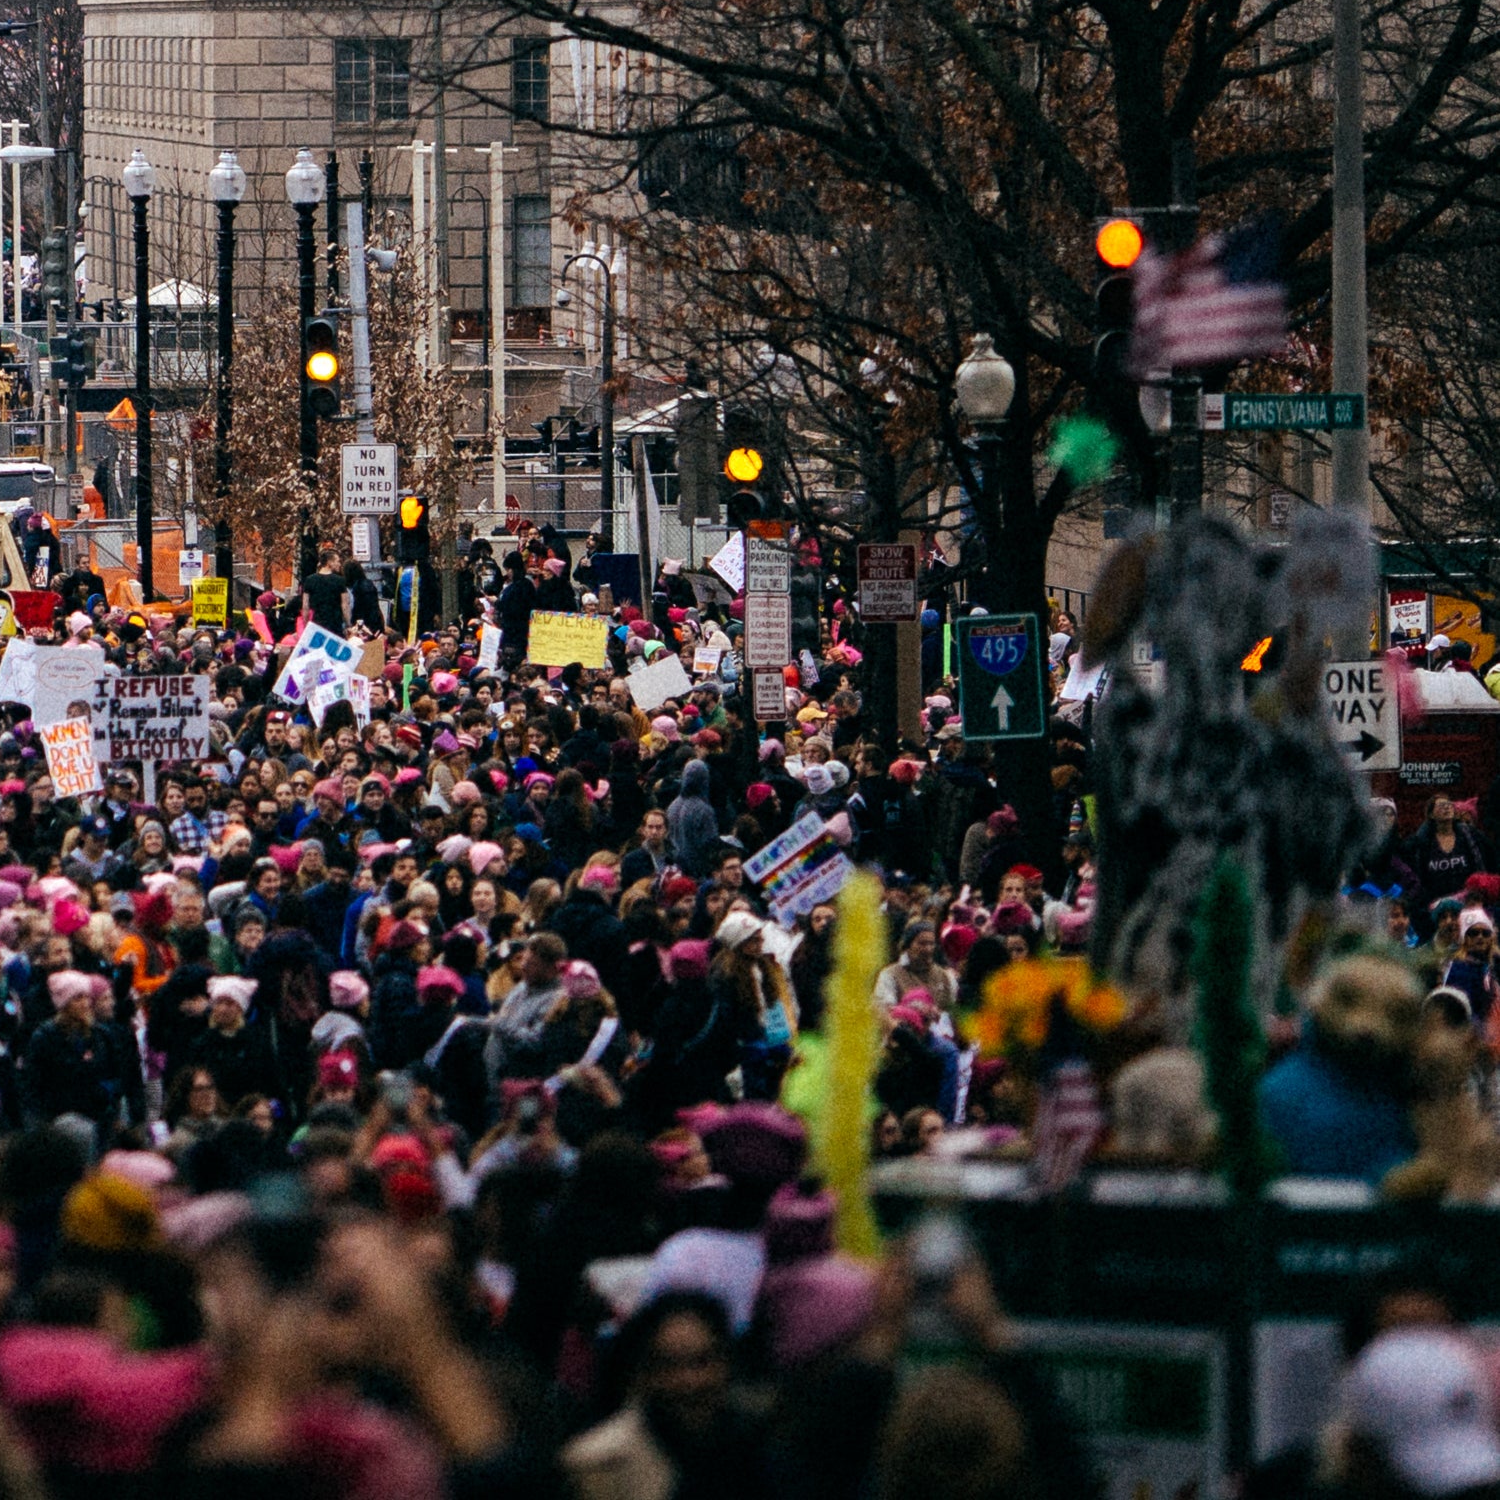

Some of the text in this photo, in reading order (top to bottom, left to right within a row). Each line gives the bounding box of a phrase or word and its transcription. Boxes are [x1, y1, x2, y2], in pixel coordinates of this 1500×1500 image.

[1231, 401, 1328, 424] PENNSYVANIA
[360, 449, 376, 460] NO
[354, 466, 385, 477] TURN
[347, 481, 391, 492] ON RED
[347, 497, 390, 508] 7AM-7PM
[750, 553, 786, 564] PARKING
[870, 547, 903, 557] SNOW
[868, 568, 905, 579] ROUTE
[863, 582, 912, 592] NO PARKING
[532, 613, 605, 630] NEW JERSEY
[750, 611, 786, 619] VEHICLES
[750, 621, 786, 629] LOADING
[981, 637, 1019, 663] 495
[94, 678, 109, 698] I
[114, 676, 194, 698] REFUSE
[1325, 668, 1385, 694] ONE
[110, 697, 203, 718] Remain Silent
[42, 722, 90, 744] WOMEN
[94, 719, 187, 741] in the Face of
[109, 738, 206, 760] BIGOTRY
[52, 756, 95, 776] OWE U
[1432, 771, 1452, 779] SPOT
[57, 772, 96, 795] SHIT
